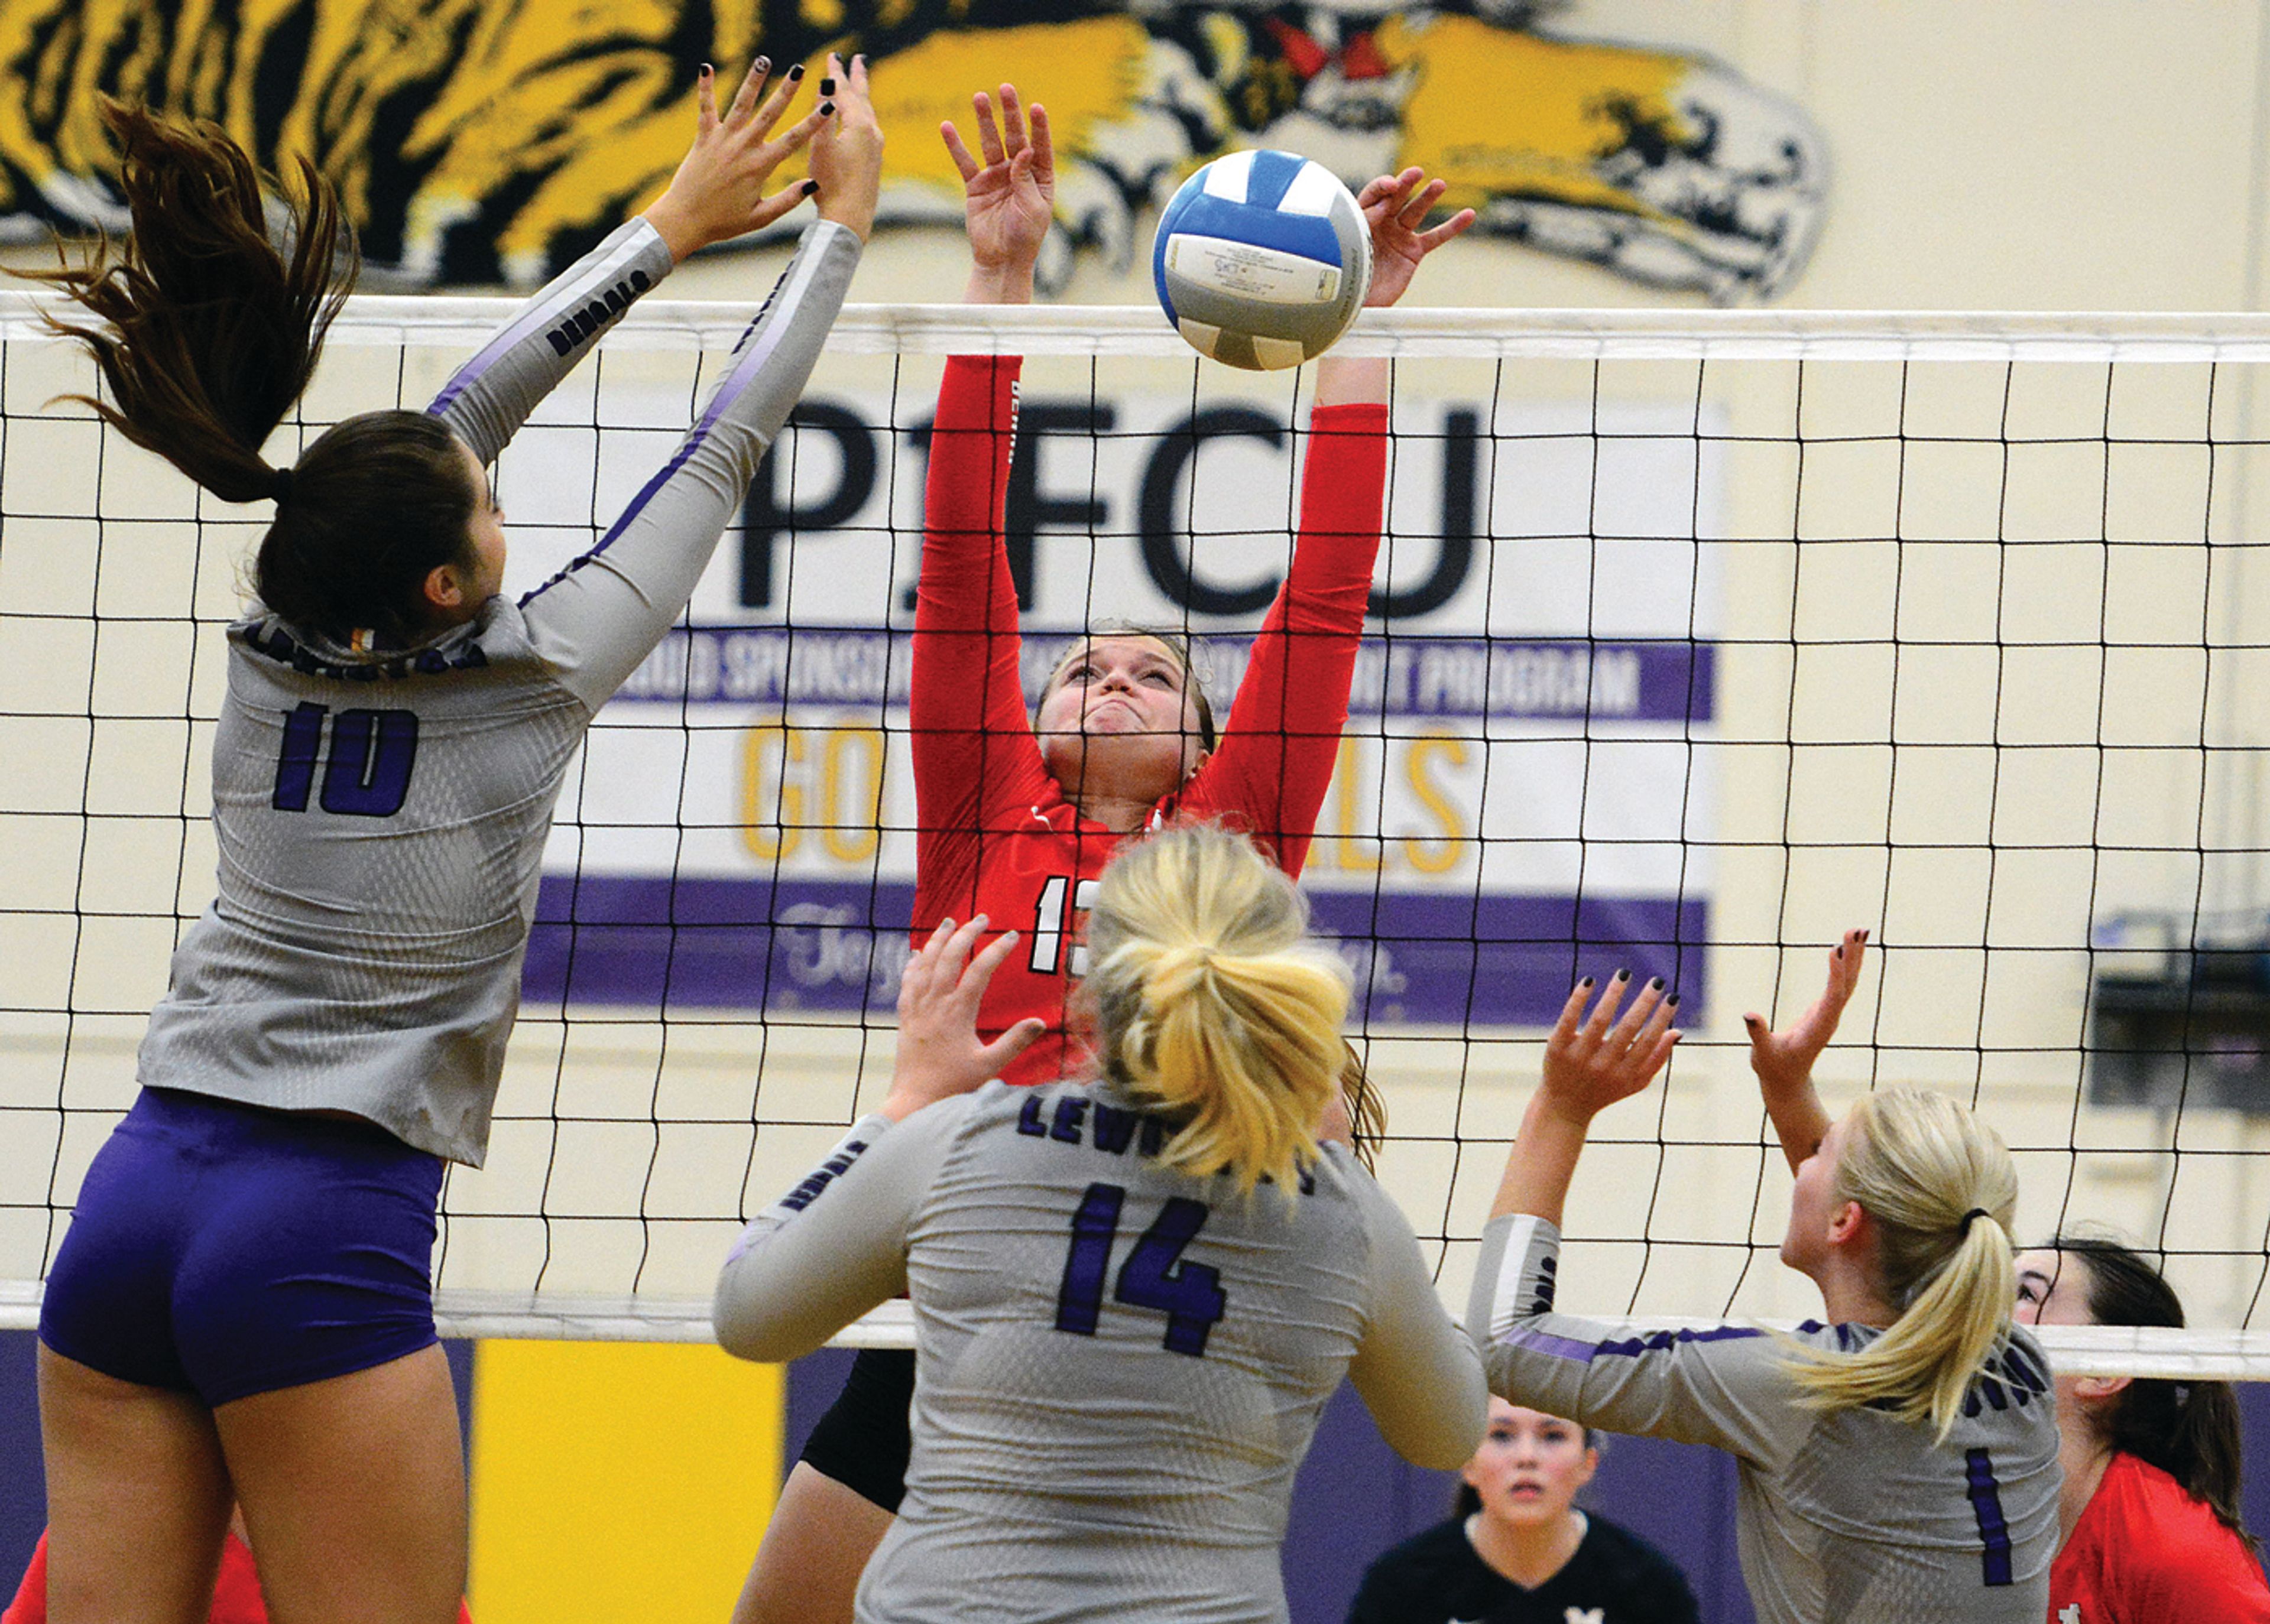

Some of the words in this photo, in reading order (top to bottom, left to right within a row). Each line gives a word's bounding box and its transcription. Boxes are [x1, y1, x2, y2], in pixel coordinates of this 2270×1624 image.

[272, 701, 419, 817] 10
[1055, 1182, 1227, 1358] 14
[1964, 1447, 2013, 1586] 1
